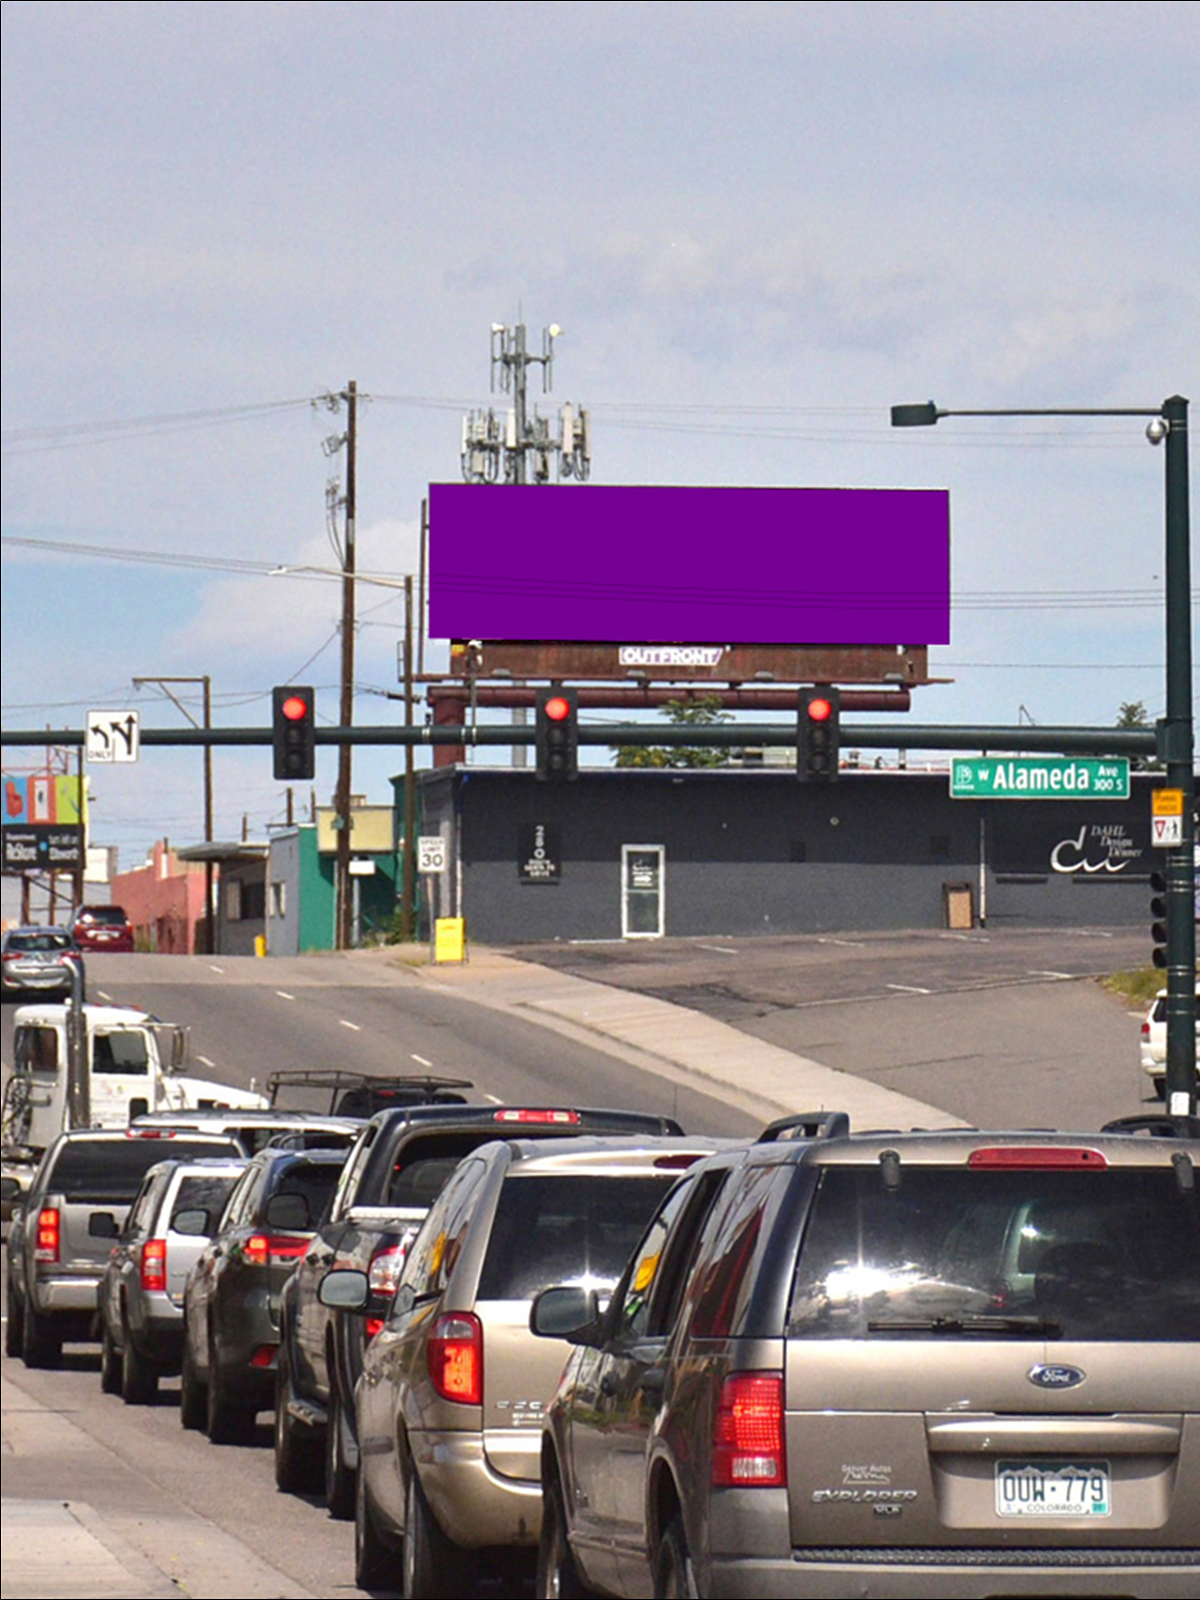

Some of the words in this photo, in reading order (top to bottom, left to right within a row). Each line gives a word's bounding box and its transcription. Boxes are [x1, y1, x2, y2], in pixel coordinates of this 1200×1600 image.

[622, 648, 718, 664] OUTFRONT
[89, 750, 112, 759] ONLY
[993, 763, 1090, 790] Alameda
[1098, 765, 1119, 777] Ave
[1093, 779, 1114, 790] 300
[1116, 779, 1124, 790] S
[1090, 824, 1127, 837] DAHL
[422, 853, 443, 867] 30
[1042, 1369, 1071, 1382] Ford
[811, 1488, 918, 1503] EXPLORER
[1026, 1503, 1083, 1512] COLORADO
